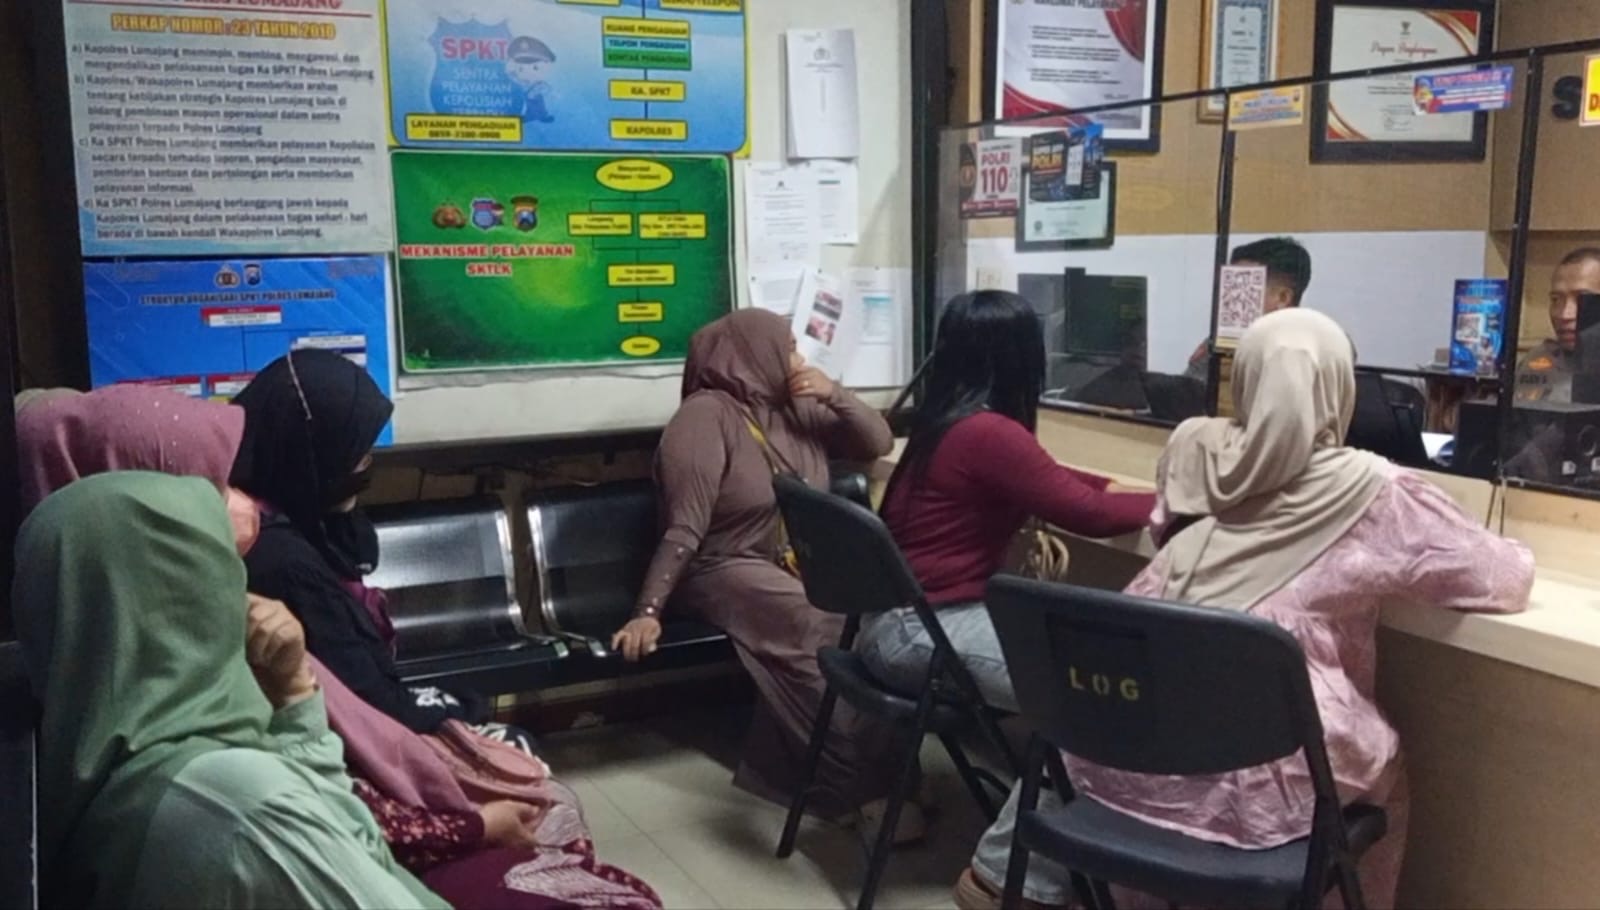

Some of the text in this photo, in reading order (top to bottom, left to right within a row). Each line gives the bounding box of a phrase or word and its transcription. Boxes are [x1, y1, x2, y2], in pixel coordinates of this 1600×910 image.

[111, 14, 167, 31] PERKAP
[170, 16, 224, 34] NOMOR
[255, 21, 299, 37] TAHUN
[638, 26, 687, 34] PENGADUAN
[85, 44, 128, 54] Kapolres
[131, 45, 179, 57] Lumajang
[442, 38, 507, 59] SPKT
[228, 65, 255, 75] tugas
[272, 65, 296, 74] SPKT
[299, 67, 327, 76] Polres
[330, 67, 374, 80] Lumajang
[453, 68, 499, 80] SENTRA
[196, 77, 243, 90] Lumajang
[246, 80, 304, 90] memberikan
[442, 81, 512, 93] PELAYANAN
[649, 87, 670, 95] SPKT
[87, 91, 126, 102] tentang
[225, 95, 266, 105] Kapolres
[269, 96, 314, 106] Lumajang
[88, 106, 121, 117] bidang
[183, 124, 213, 132] Polres
[216, 125, 262, 135] Lumajang
[411, 120, 516, 130] LAYANAN PENGADUAN
[626, 127, 672, 135] KAPOLRES
[91, 137, 103, 146] Ka
[107, 137, 132, 146] SPKT
[136, 137, 166, 147] Polres
[169, 138, 217, 149] Lumajang
[220, 139, 277, 149] memberikan
[92, 154, 125, 162] secara
[128, 153, 165, 163] terpadu
[168, 153, 211, 164] terhadap
[256, 155, 306, 165] pengaduan
[982, 152, 1011, 165] POLRI
[191, 168, 209, 177] dan
[982, 166, 1008, 193] 110
[111, 198, 137, 207] SPKT
[141, 198, 171, 208] Polres
[175, 199, 221, 210] Lumajang
[97, 214, 139, 224] Kapolres
[143, 214, 191, 225] Lumajang
[287, 214, 312, 224] tugas
[219, 228, 273, 239] Wakapolres
[401, 245, 573, 257] MEKANISME PELAYANAN
